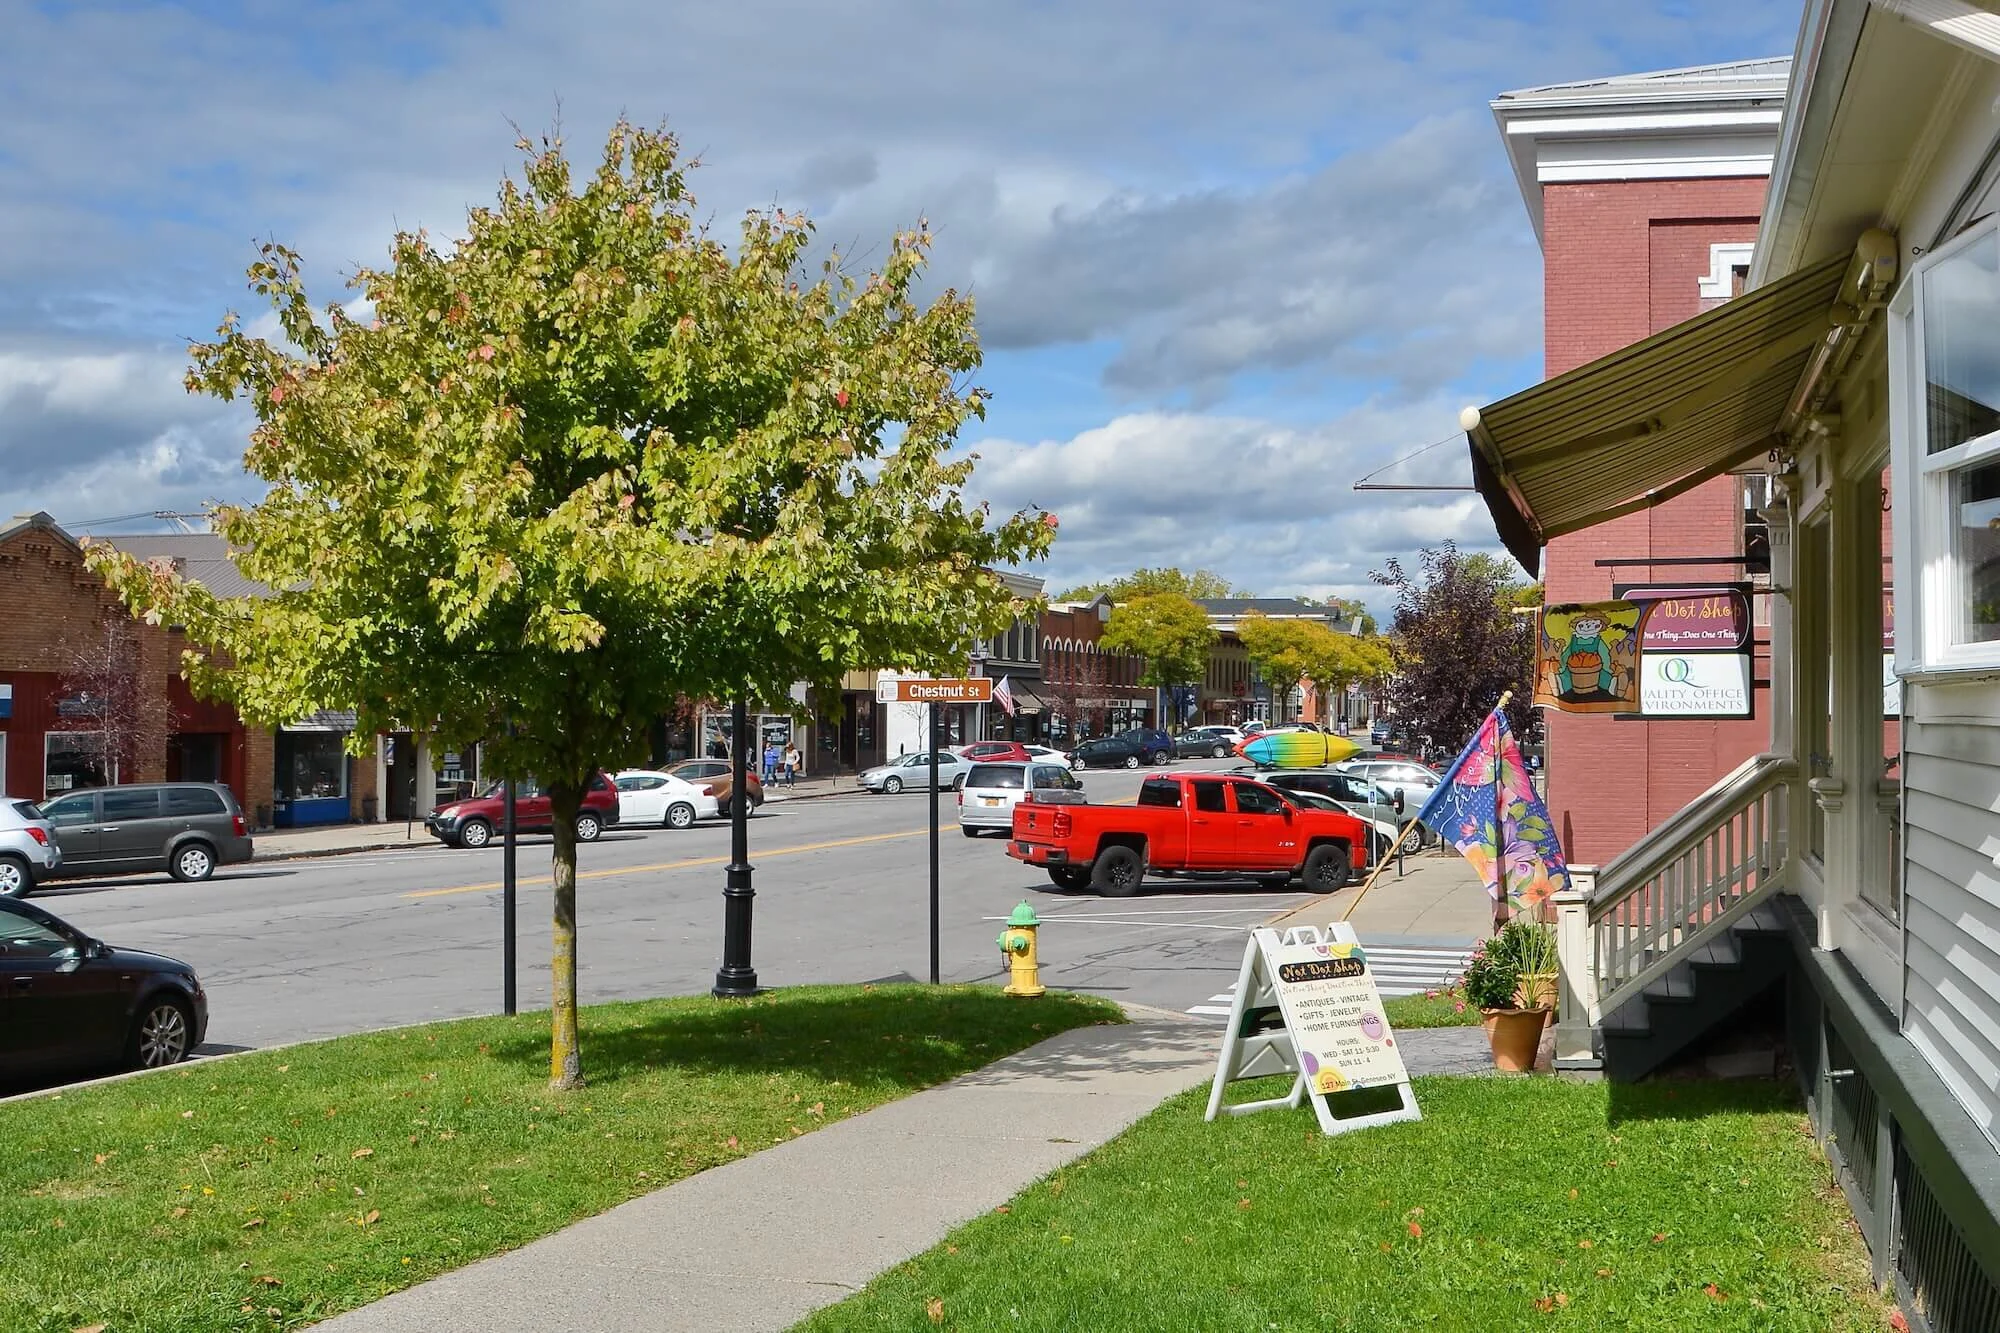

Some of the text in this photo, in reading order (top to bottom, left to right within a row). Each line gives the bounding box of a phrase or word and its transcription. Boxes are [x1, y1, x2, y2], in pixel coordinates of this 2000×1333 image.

[1662, 597, 1741, 626] Dot Shop
[1702, 630, 1715, 639] One
[1717, 629, 1739, 642] Thing
[909, 684, 980, 698] Chestnut St
[1644, 689, 1743, 699] ALITY OFFICE
[1645, 700, 1743, 710] VIRONMENTS
[1284, 959, 1361, 979] Not Dot Shop
[1299, 997, 1336, 1008] ANTIQUES
[1340, 994, 1371, 1004] VINTAGE
[1303, 1011, 1325, 1020] GIFTS
[1330, 1007, 1361, 1017] JEWELRY
[1306, 1016, 1380, 1032] HOME FURNISHINGS
[1322, 1051, 1338, 1059] WED
[1342, 1048, 1353, 1056] SAT
[1339, 1059, 1353, 1067] SUN
[1321, 1081, 1334, 1090] 127
[1335, 1079, 1351, 1087] Main
[1387, 1072, 1397, 1080] NY
